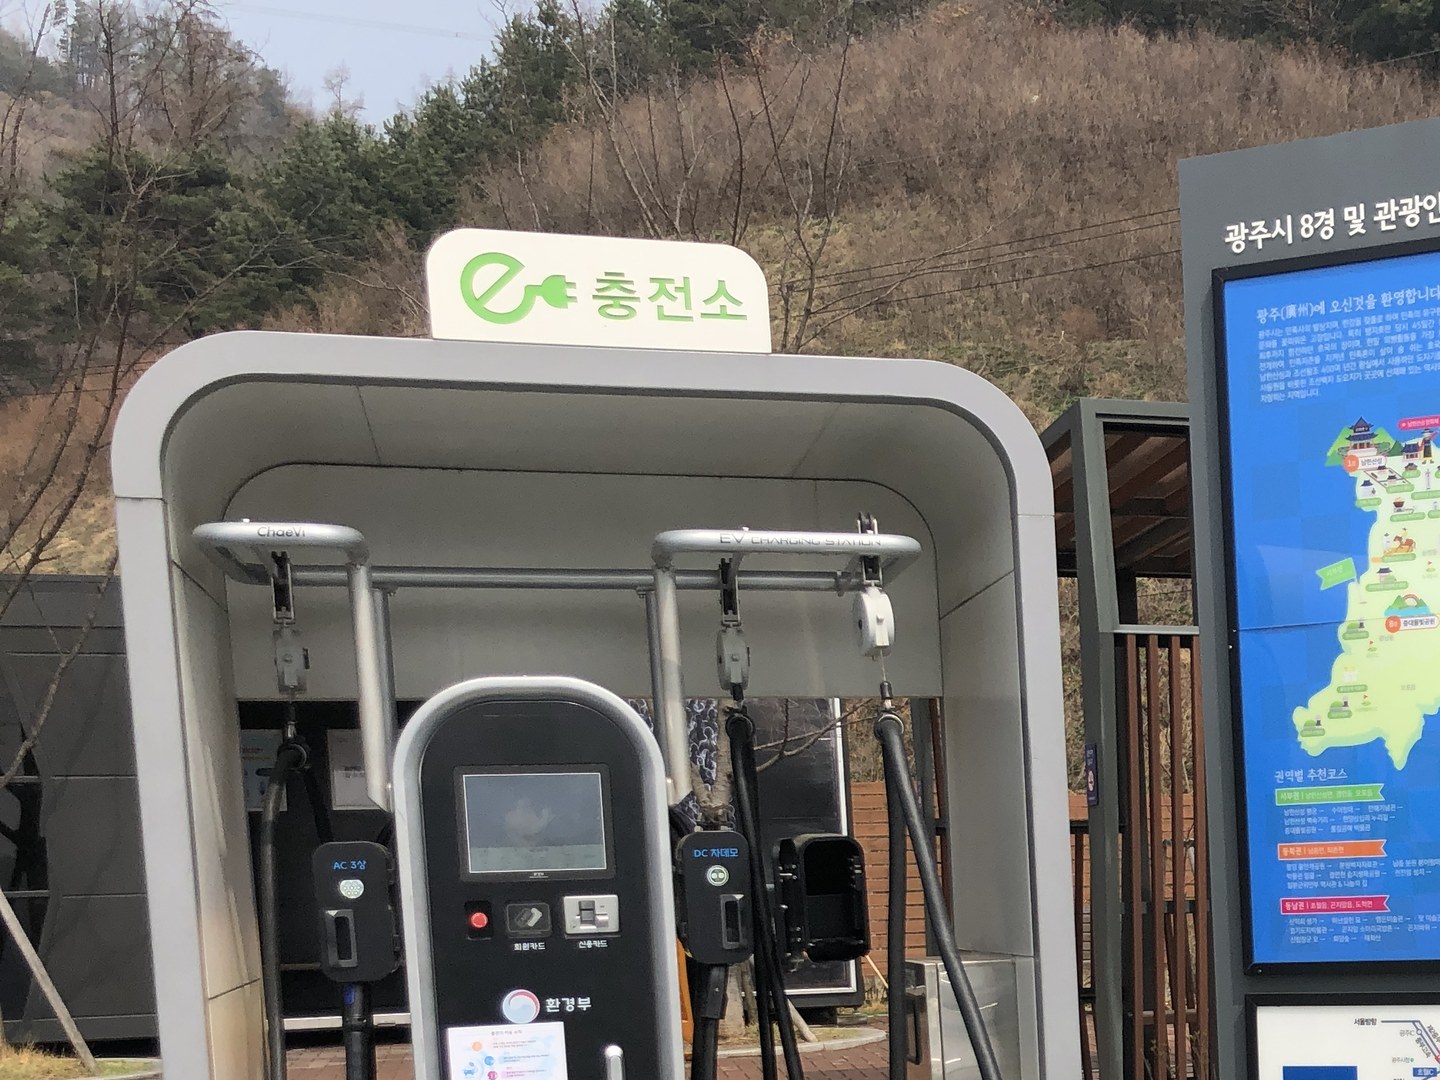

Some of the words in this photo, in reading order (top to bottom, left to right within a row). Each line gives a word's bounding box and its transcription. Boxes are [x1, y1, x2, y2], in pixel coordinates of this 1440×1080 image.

[1224, 214, 1293, 253] 광주시
[1300, 208, 1335, 241] 8경
[1343, 203, 1366, 236] 및
[592, 271, 748, 322] 충전소
[1329, 294, 1377, 313] 오신것을
[257, 526, 306, 538] ChaeVi
[720, 532, 745, 544] EV
[1275, 769, 1304, 783] 권역별
[1307, 768, 1348, 782] 추천코스
[694, 849, 708, 858] DC
[710, 848, 739, 857] 차데모
[333, 861, 348, 870] AC
[350, 859, 367, 870] 3상
[545, 997, 592, 1013] 환경부
[1353, 1017, 1377, 1026] 서울방향
